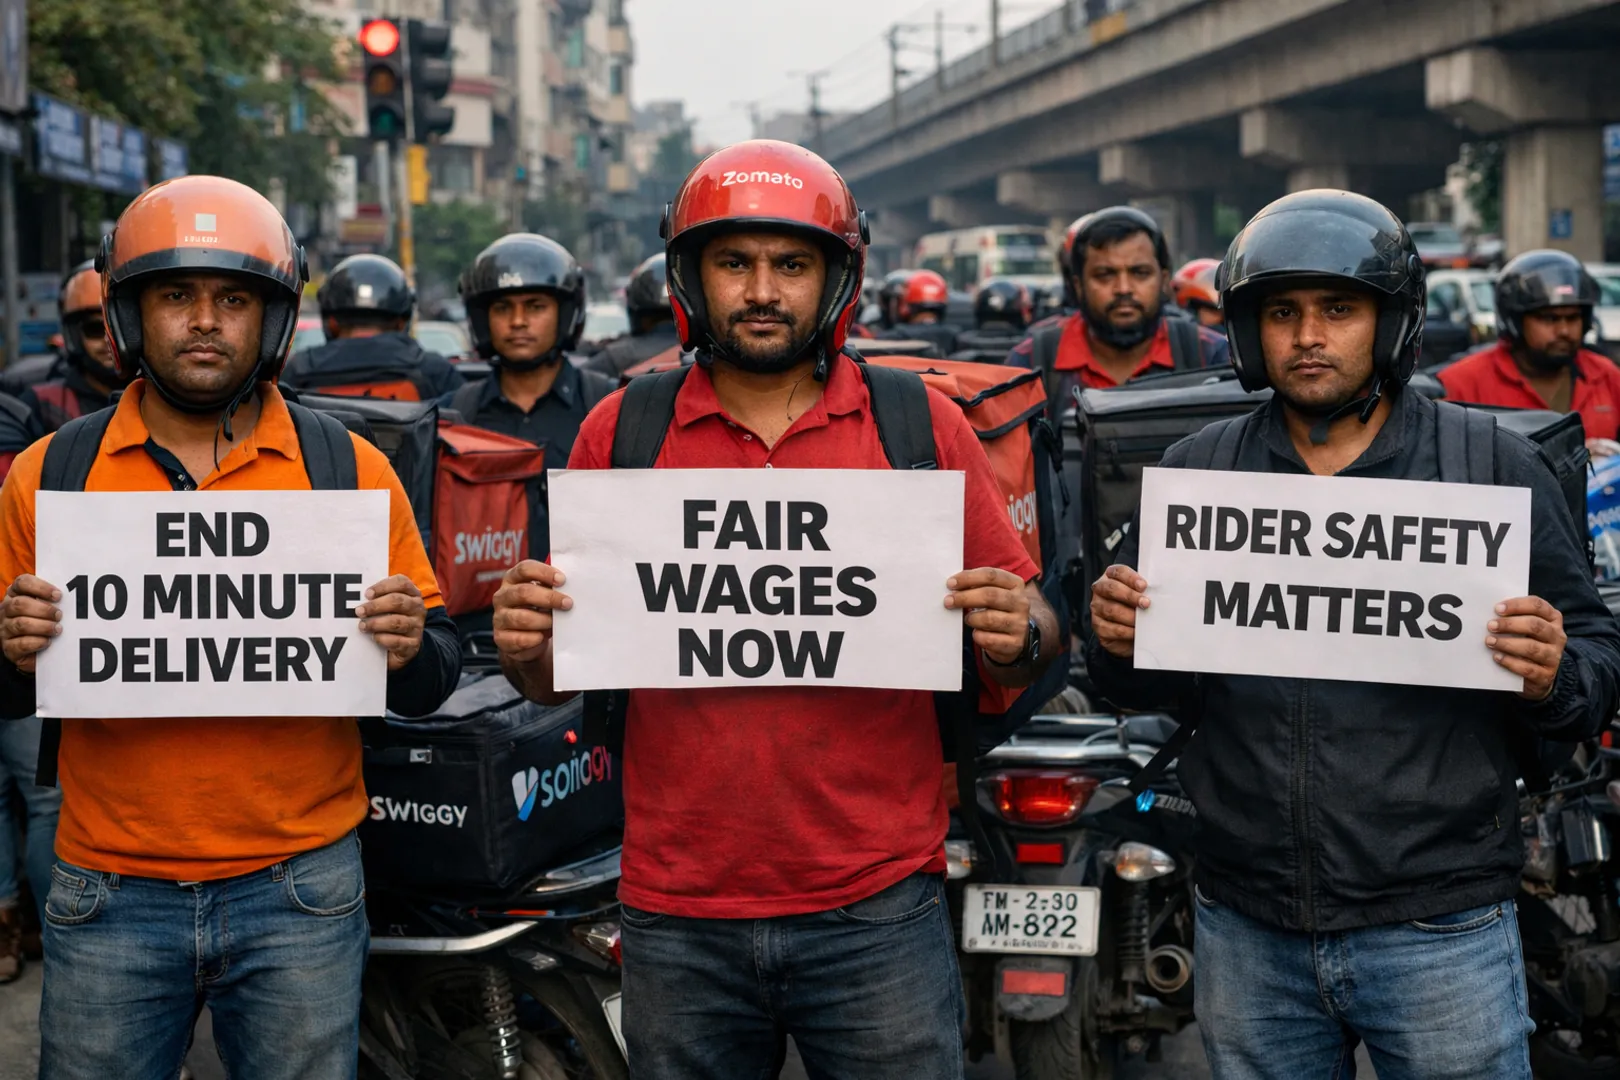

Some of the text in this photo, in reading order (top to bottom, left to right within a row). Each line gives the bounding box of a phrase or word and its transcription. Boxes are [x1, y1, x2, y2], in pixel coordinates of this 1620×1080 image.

[721, 170, 803, 190] Zomato
[156, 511, 270, 557] END
[683, 499, 831, 552] FAIR
[1166, 504, 1512, 568] RIDER SAFETY
[66, 573, 362, 620] 10 MINUTE
[636, 562, 877, 618] WAGES
[1203, 580, 1464, 641] MATTERS
[79, 636, 348, 683] DELIVERY
[679, 628, 844, 679] NOW
